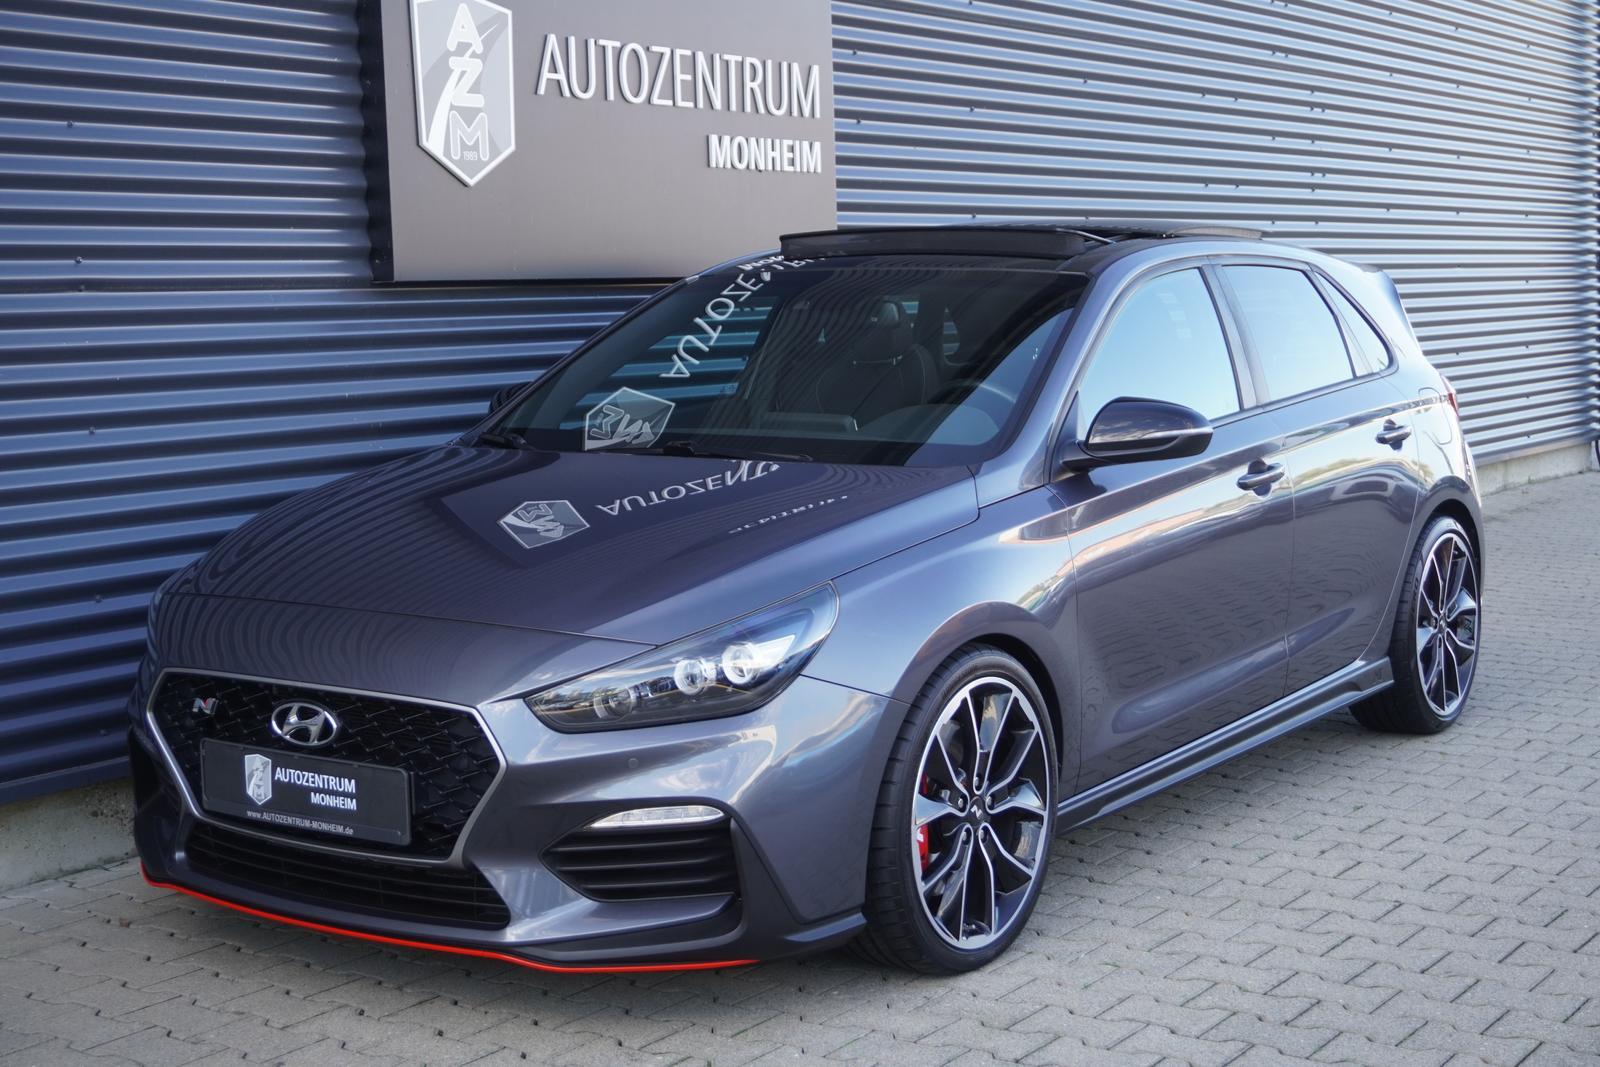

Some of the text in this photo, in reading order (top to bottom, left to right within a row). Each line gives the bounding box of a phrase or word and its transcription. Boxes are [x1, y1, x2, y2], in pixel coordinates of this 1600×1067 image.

[536, 33, 821, 119] AUTOZENTRUM
[708, 133, 822, 173] MONHEIM
[274, 766, 356, 794] AUTOZENTRUM
[310, 791, 357, 811] MONHEIM
[246, 809, 354, 835] www.AUTOZENTRUM-MONHEIM.de
